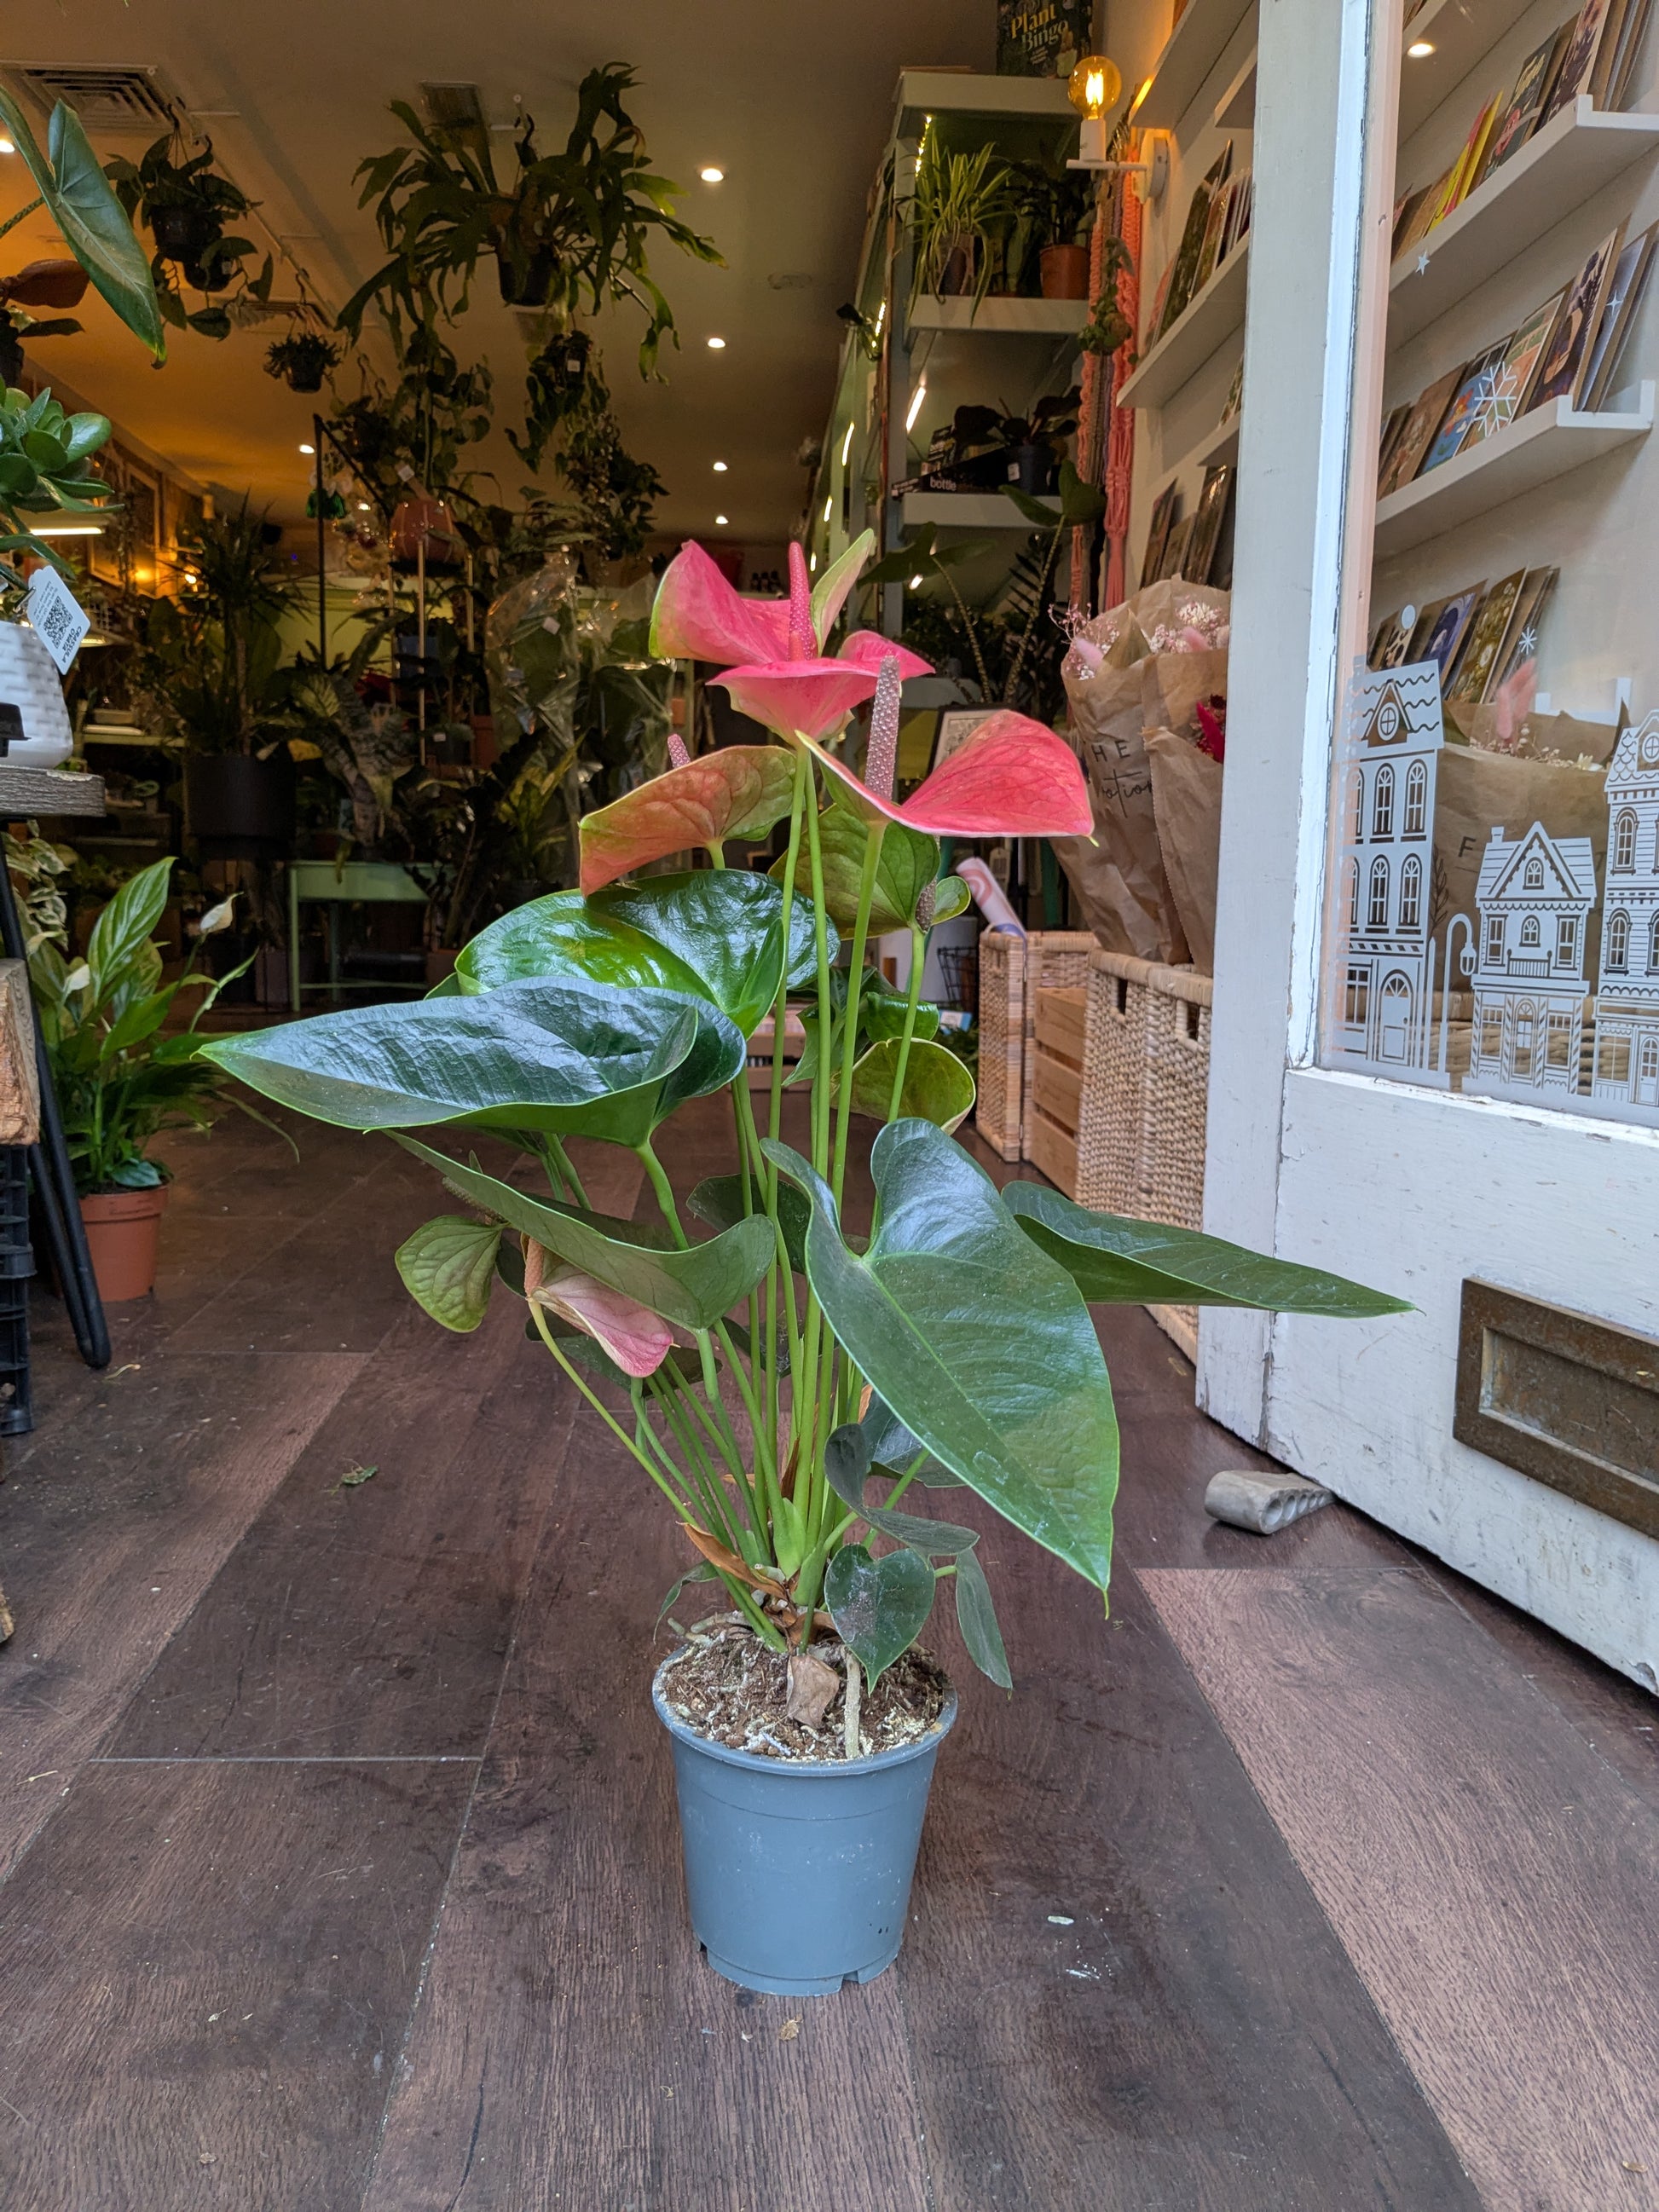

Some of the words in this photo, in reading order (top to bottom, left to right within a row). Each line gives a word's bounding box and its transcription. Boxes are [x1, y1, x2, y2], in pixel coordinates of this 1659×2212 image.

[1011, 3, 1057, 39] Plant
[1022, 20, 1069, 52] Bingo
[929, 476, 957, 491] bottle
[61, 626, 82, 663] CRASSULA
[62, 628, 75, 651] OVATA
[1091, 739, 1131, 763] HE
